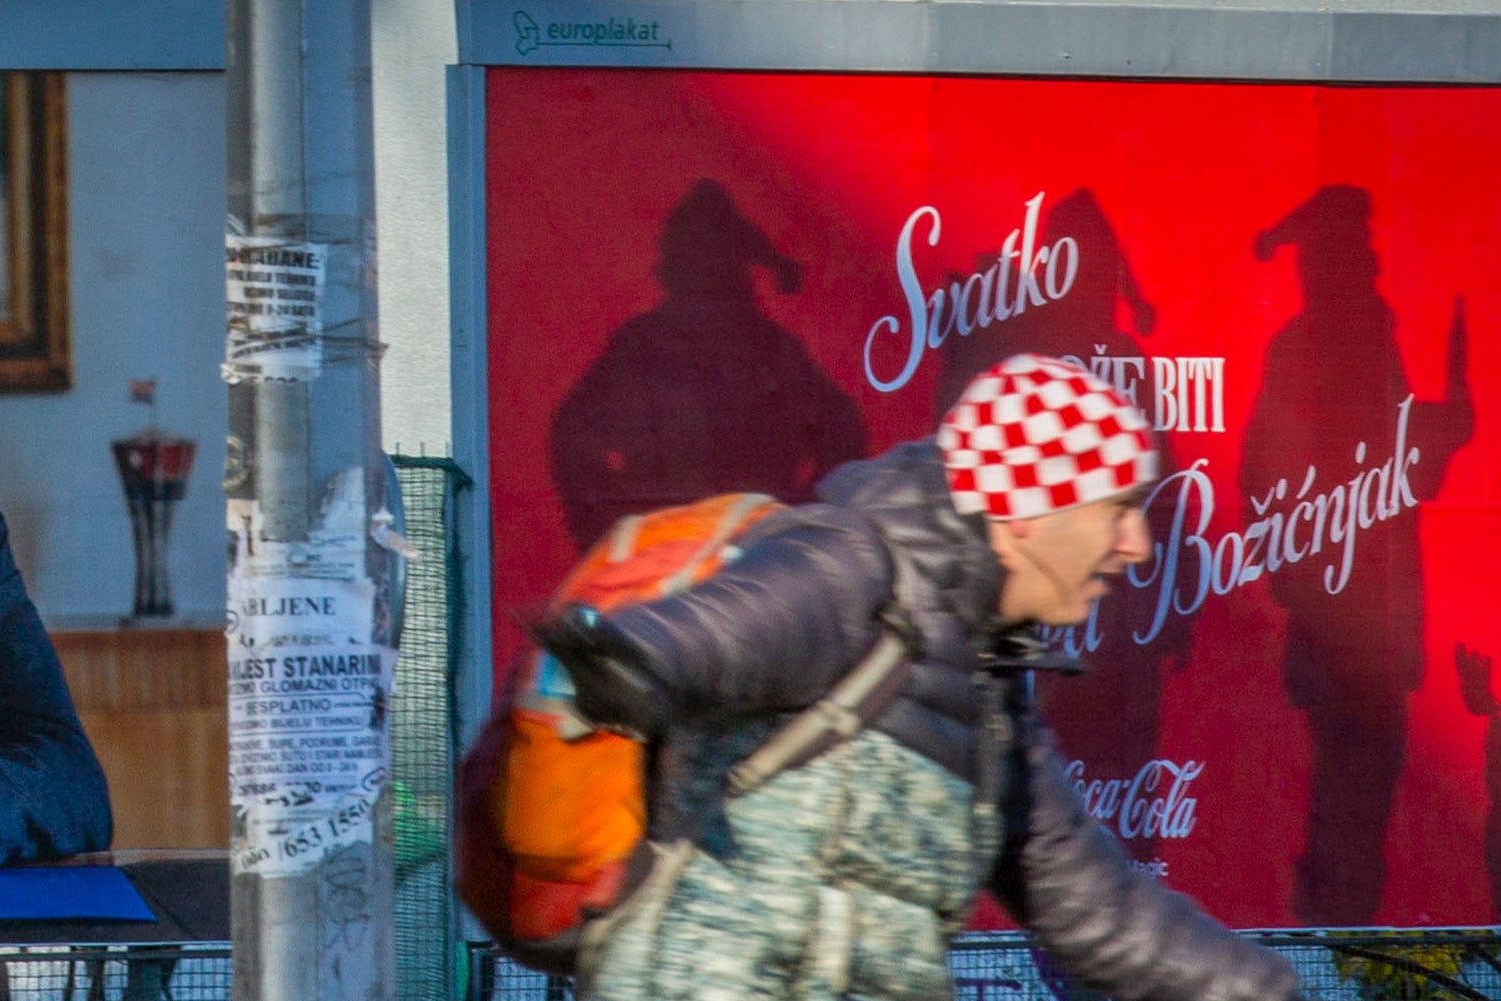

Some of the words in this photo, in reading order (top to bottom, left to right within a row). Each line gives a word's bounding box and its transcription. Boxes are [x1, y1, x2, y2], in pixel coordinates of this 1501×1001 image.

[547, 18, 659, 43] europlakat
[864, 191, 1079, 393] Svatko
[1152, 356, 1226, 433] BITI
[1126, 393, 1421, 645] Božićnjak
[246, 699, 332, 715] BESPLATNO
[261, 680, 338, 693] GLOMAZNI
